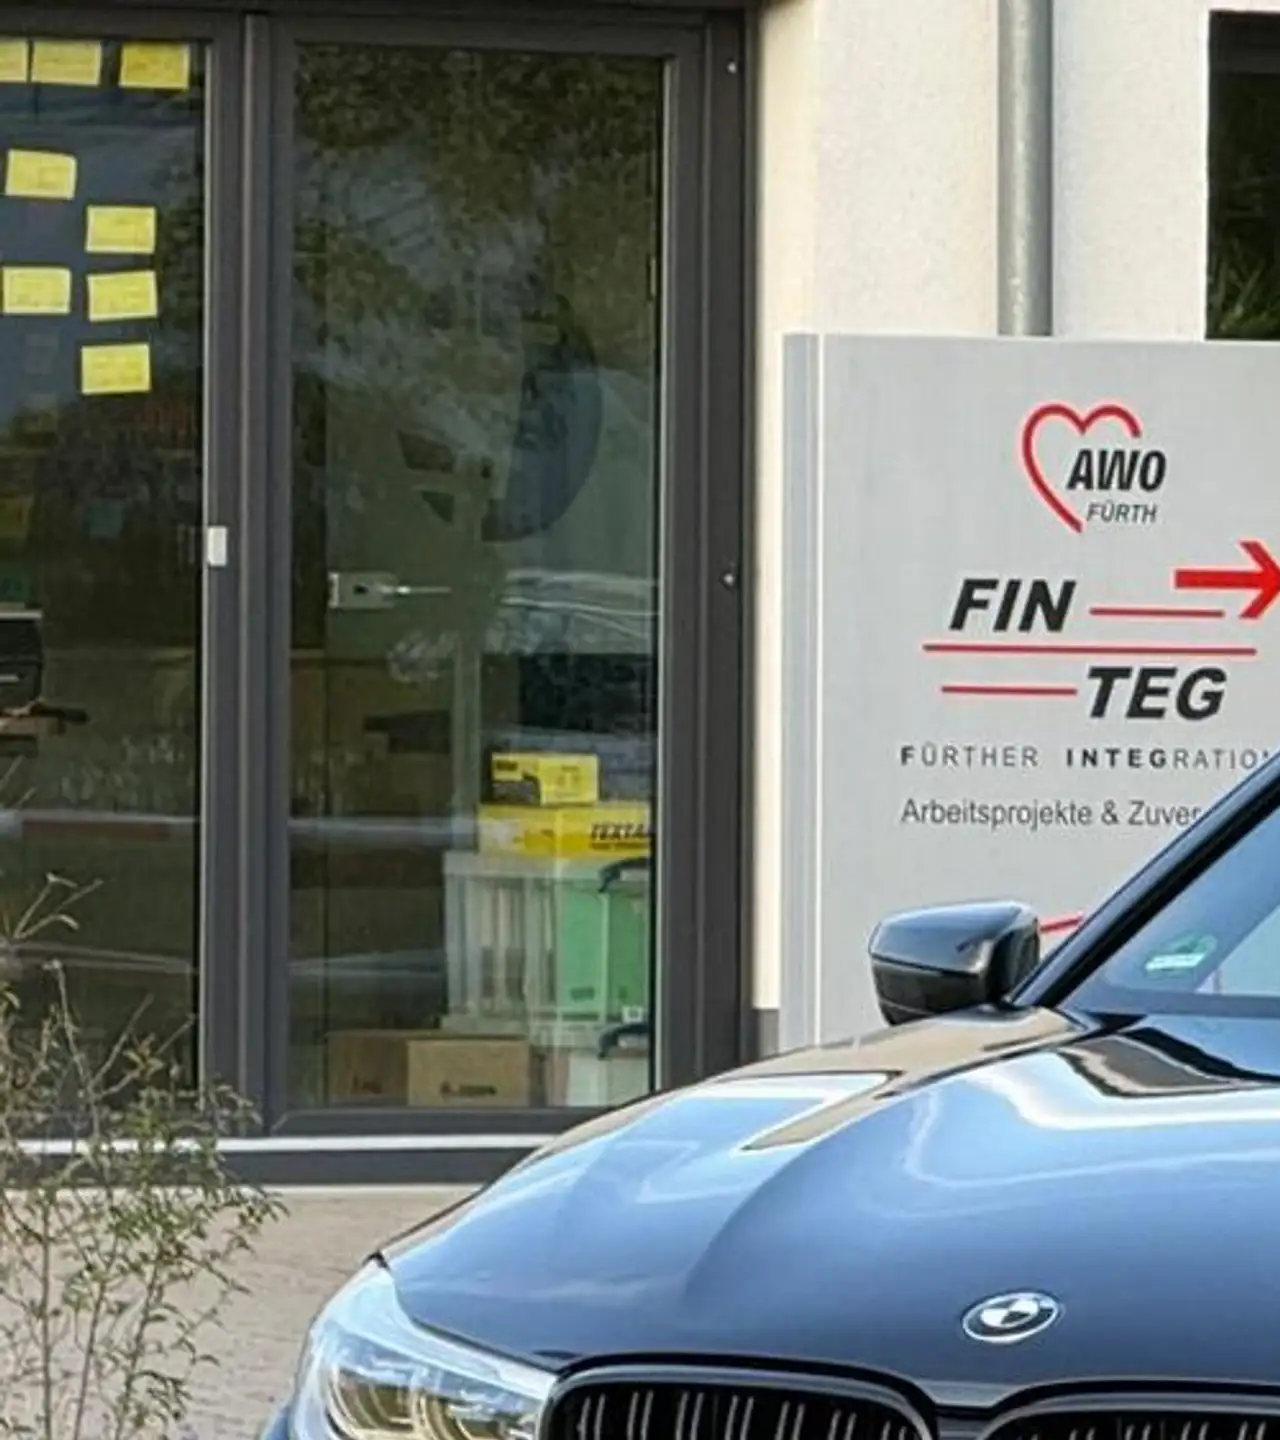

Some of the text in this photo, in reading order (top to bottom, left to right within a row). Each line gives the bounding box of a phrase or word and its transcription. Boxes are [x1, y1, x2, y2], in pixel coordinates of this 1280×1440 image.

[1066, 449, 1167, 493] AWO
[1086, 500, 1158, 524] FÜRTH
[949, 578, 1077, 633] FIN
[1088, 666, 1227, 721] TEG
[900, 745, 1269, 770] FÜRTHER INTEGRATIO
[900, 798, 1093, 830] Arbeitsprojekte
[1100, 800, 1120, 826] &
